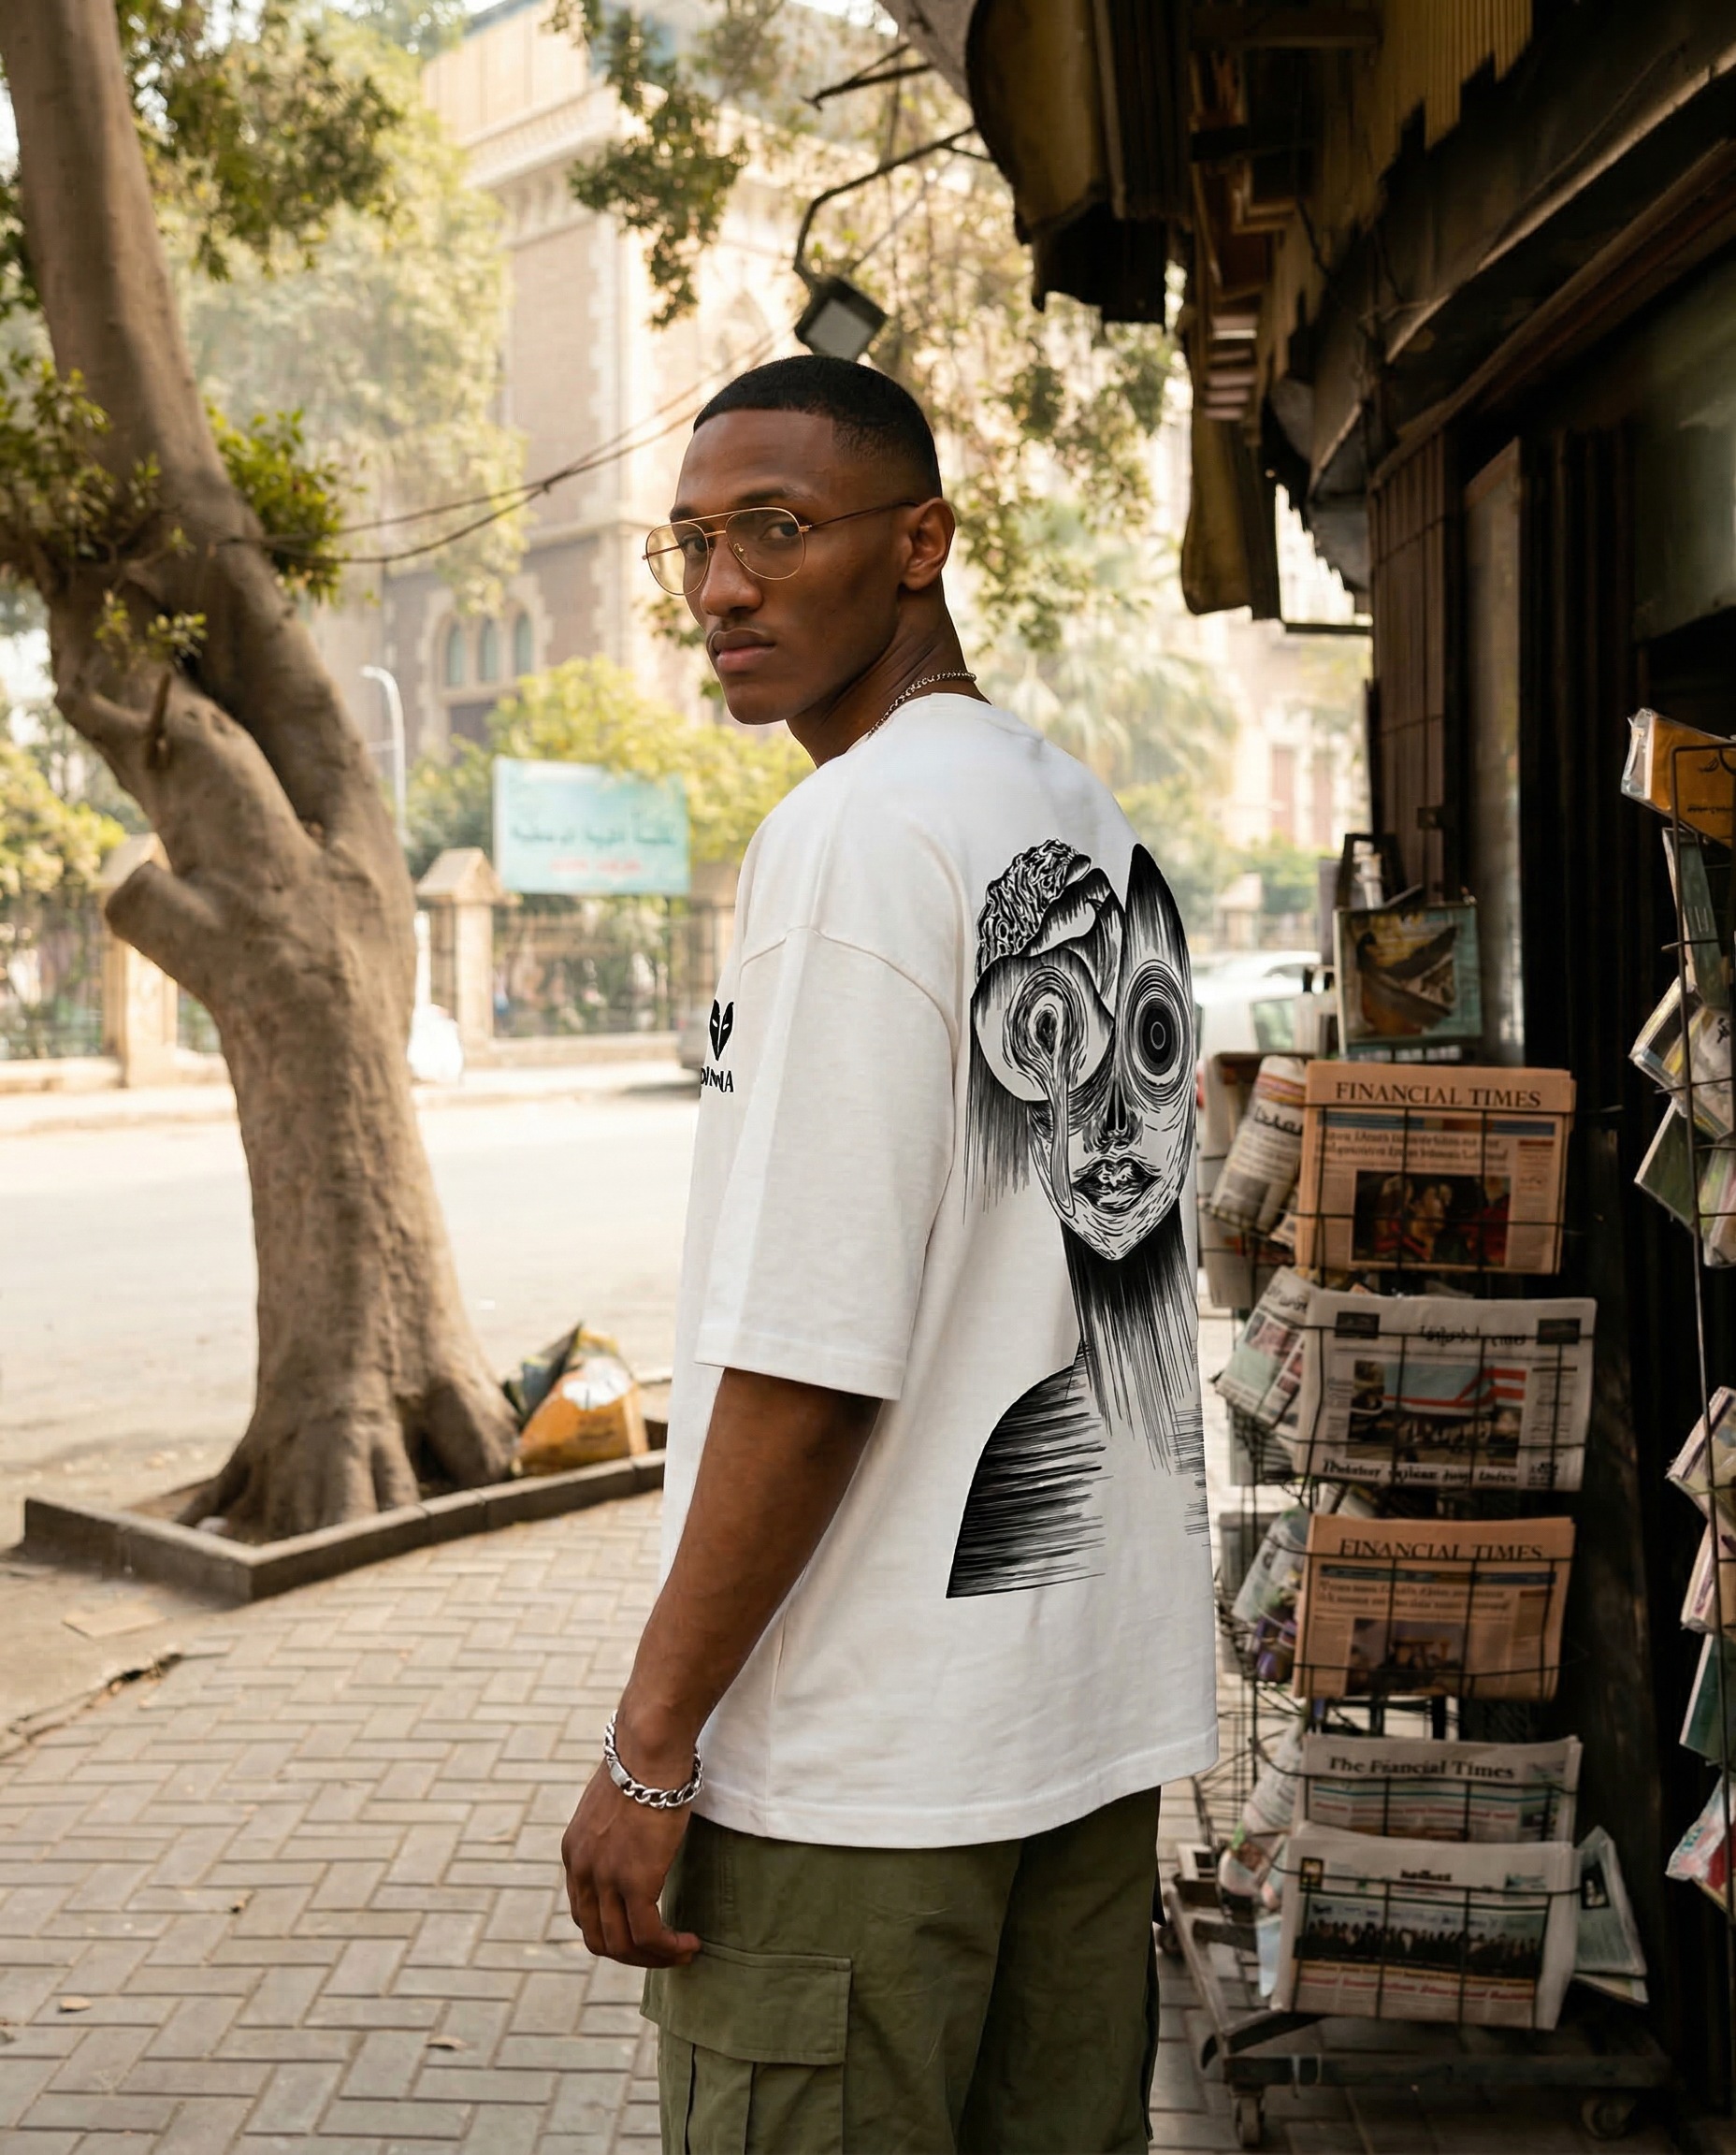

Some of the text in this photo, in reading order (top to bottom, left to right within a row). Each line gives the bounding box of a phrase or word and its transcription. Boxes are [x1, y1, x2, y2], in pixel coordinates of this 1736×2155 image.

[1336, 1081, 1541, 1109] FINANCIAL TIMES
[1338, 1537, 1543, 1560] FINANCIAL TIMES
[1328, 1756, 1365, 1773] The
[1451, 1760, 1514, 1779] Times
